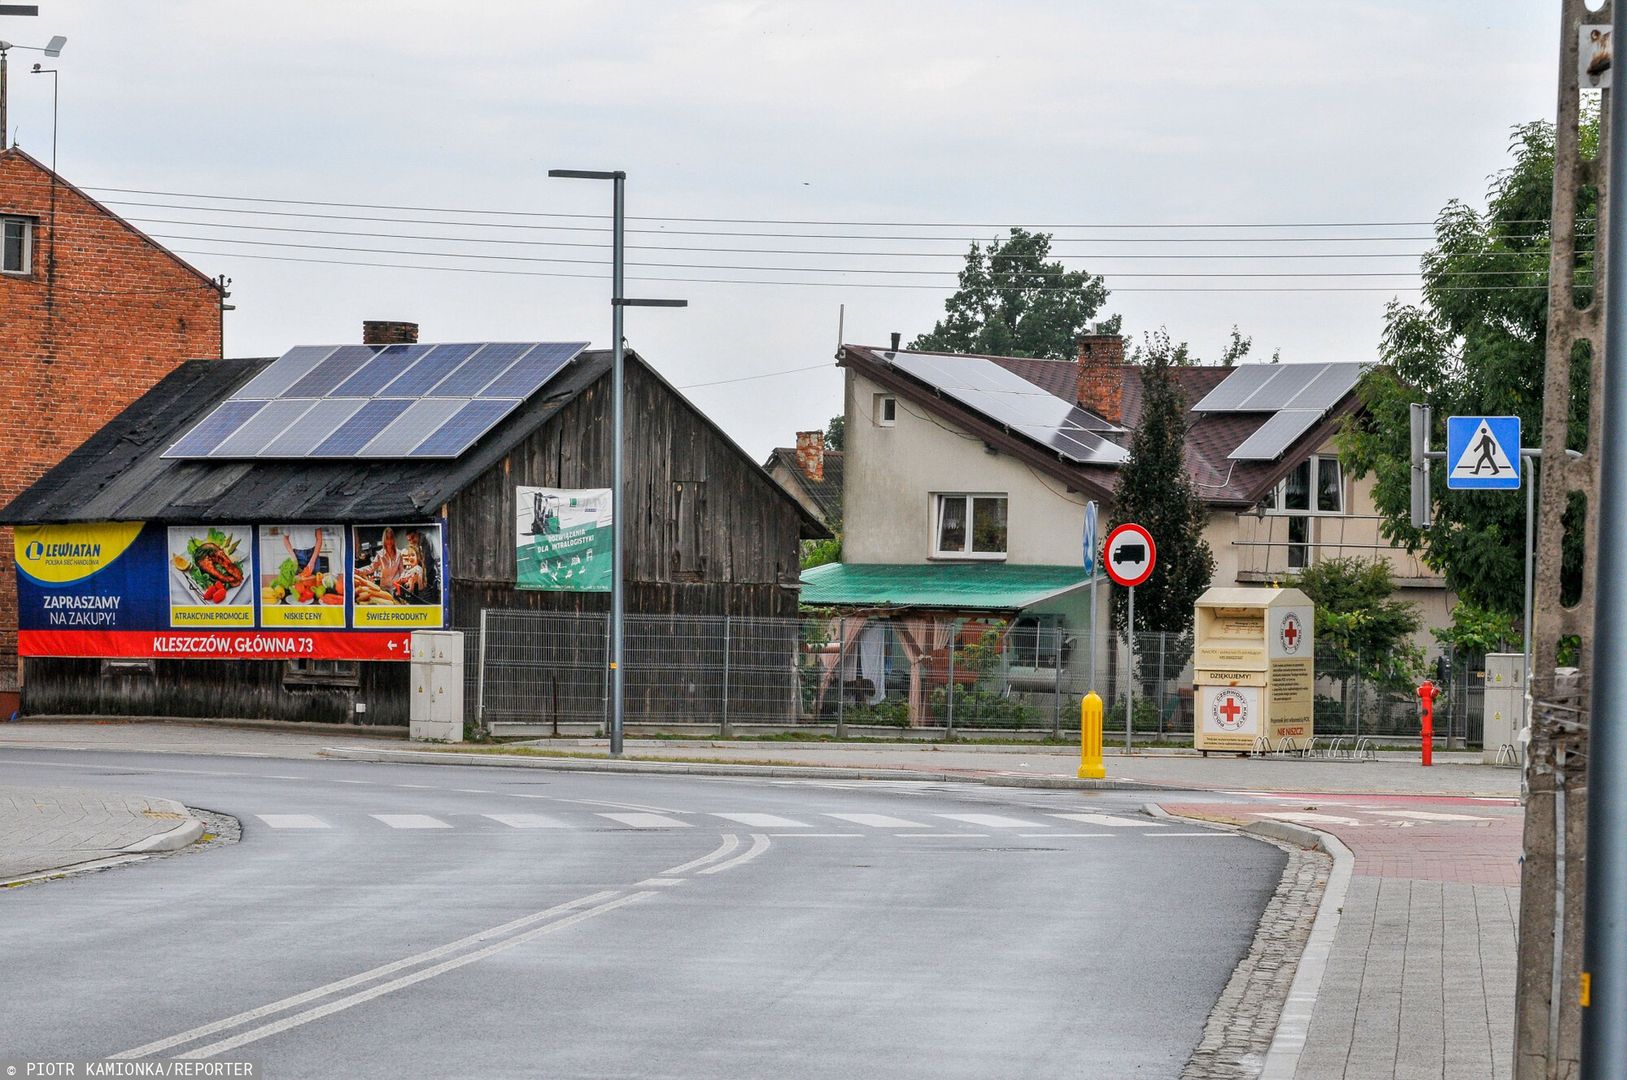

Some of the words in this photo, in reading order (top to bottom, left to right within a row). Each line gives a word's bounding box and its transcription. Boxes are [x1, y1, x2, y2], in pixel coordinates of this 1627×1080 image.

[45, 542, 101, 557] LEWIATAN
[537, 544, 550, 554] DLA
[43, 595, 121, 610] ZAPRASZAMY
[49, 611, 67, 625] NA
[68, 611, 116, 626] ZAKUPY!
[174, 612, 215, 621] ATRAKCYJNE
[215, 612, 250, 621] PROMOCJE
[283, 612, 304, 621] NISKIE
[304, 612, 323, 621] CENY
[366, 611, 391, 621] ŚWIEŻE
[391, 612, 428, 621] PRODUKTY
[153, 634, 234, 654] KLESZCZÓW,
[235, 634, 296, 654] GŁÓWNA
[298, 637, 314, 653] 73
[402, 638, 412, 654] 1
[1216, 690, 1247, 704] CZERWONY
[1276, 727, 1287, 736] NIE
